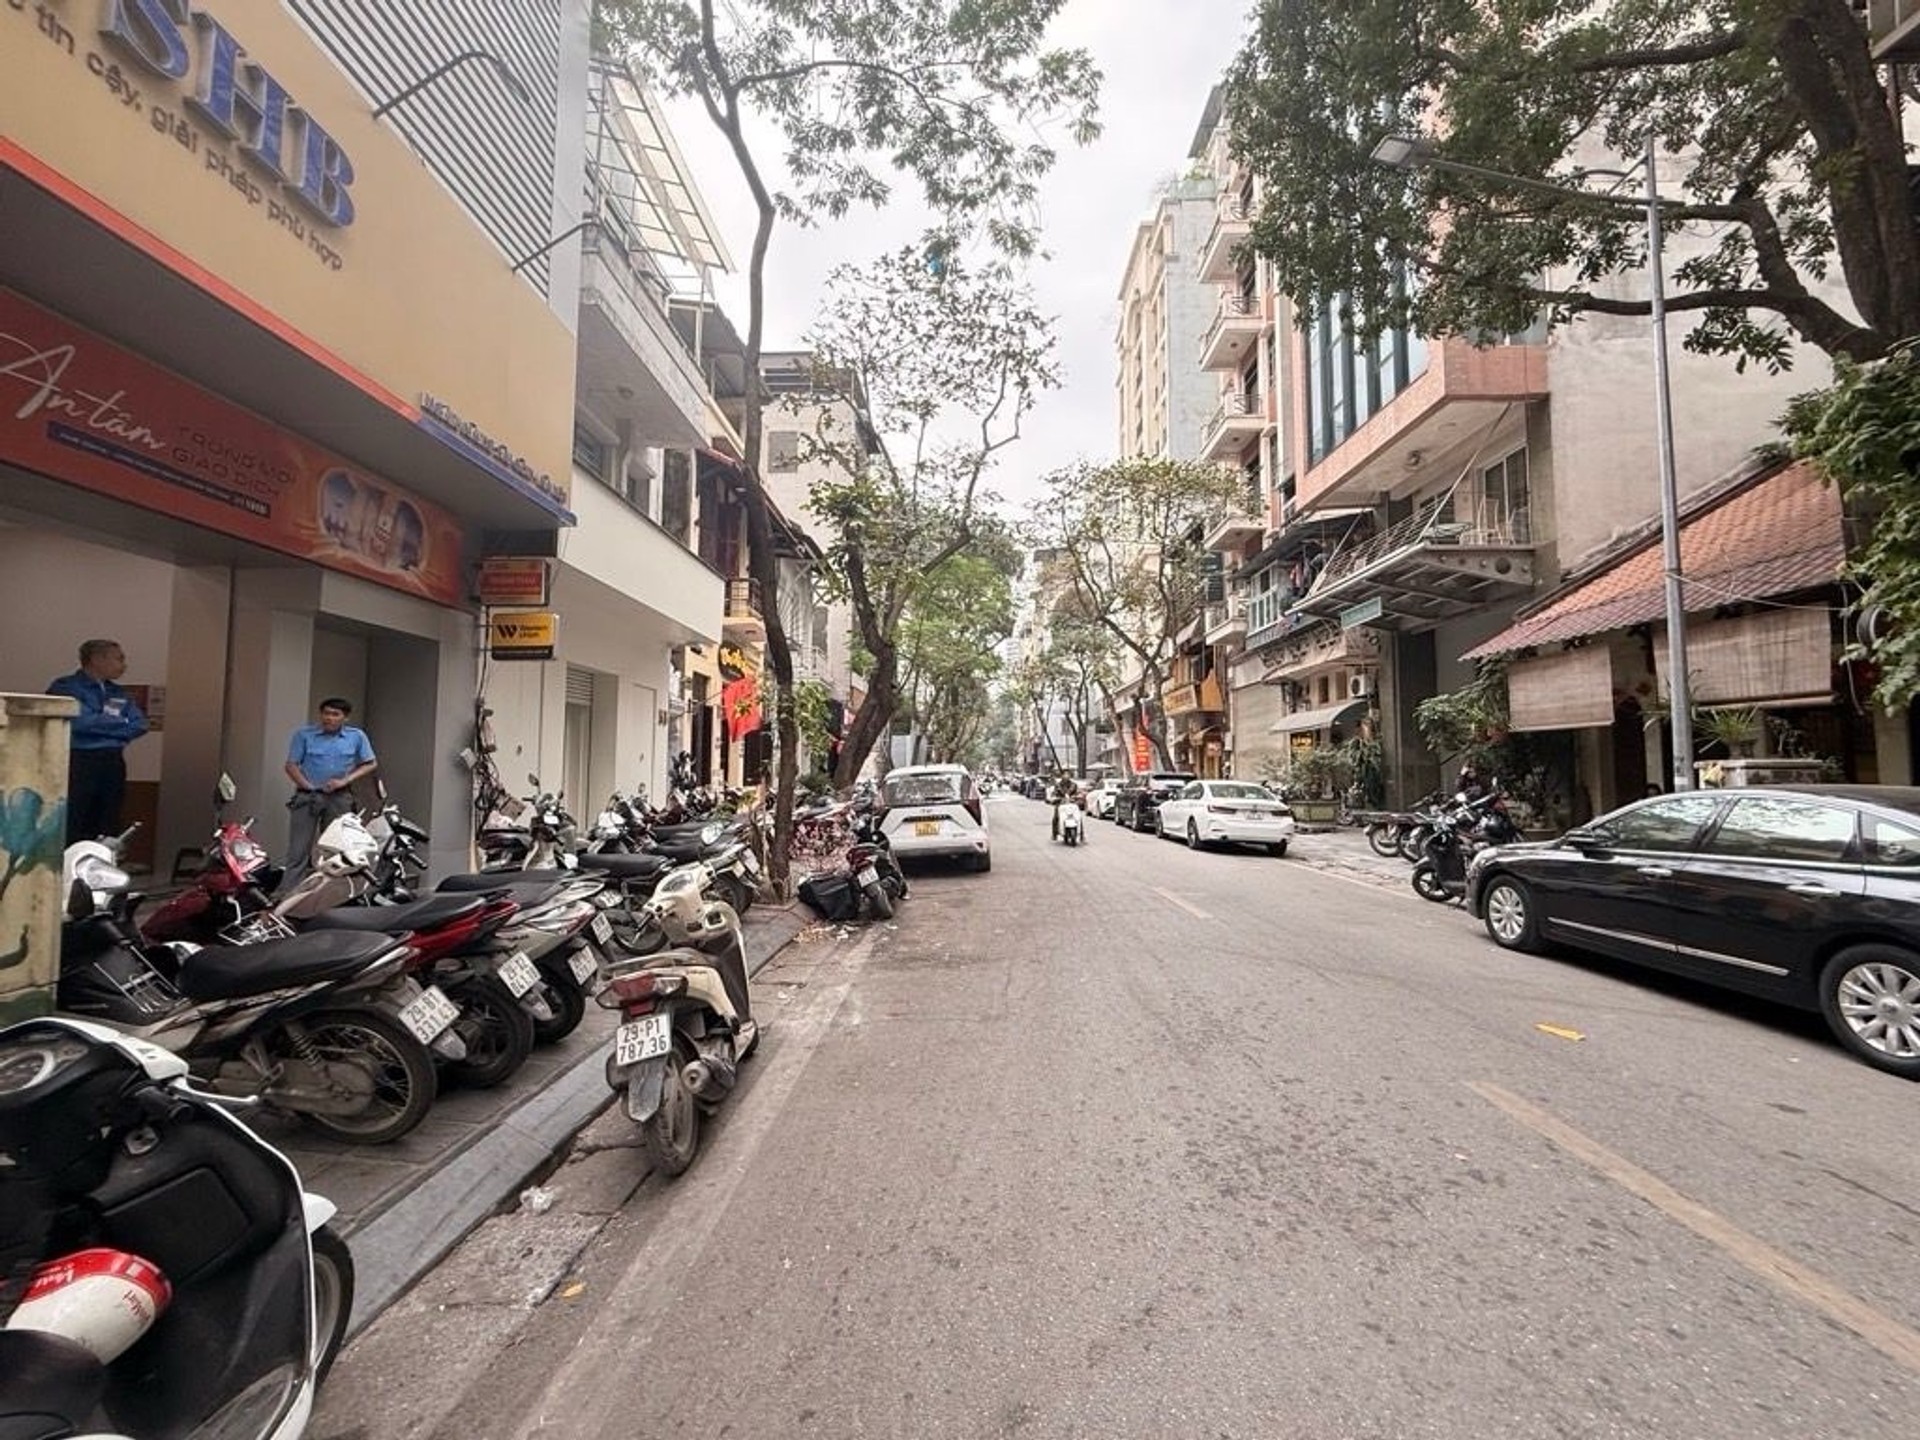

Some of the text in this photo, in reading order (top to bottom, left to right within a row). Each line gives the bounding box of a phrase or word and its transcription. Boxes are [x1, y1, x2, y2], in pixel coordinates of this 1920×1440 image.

[100, 0, 355, 228] SHB
[205, 147, 262, 204] pháp
[75, 389, 166, 449] tâm
[619, 1035, 667, 1062] 787.36
[623, 1018, 660, 1043] 29-P1
